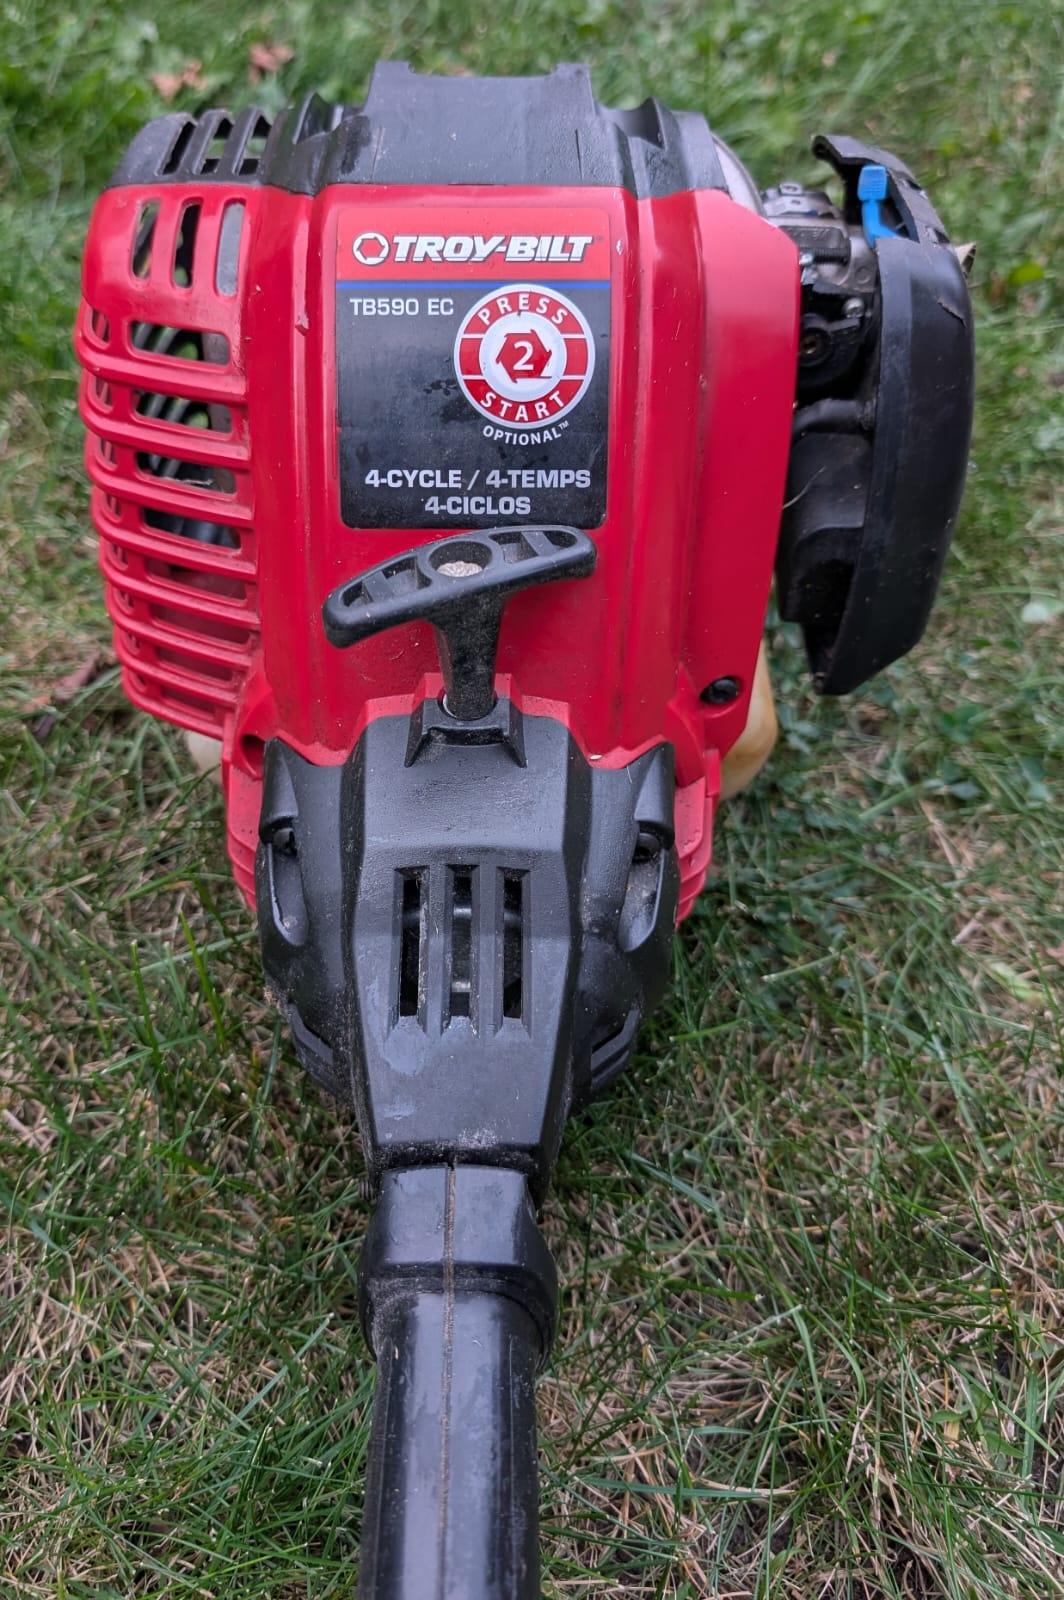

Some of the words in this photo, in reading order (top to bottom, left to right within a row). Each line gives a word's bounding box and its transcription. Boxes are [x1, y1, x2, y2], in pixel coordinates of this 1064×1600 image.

[392, 235, 594, 263] TROY-BILT
[349, 298, 419, 316] TB590
[427, 298, 454, 316] EC
[477, 293, 568, 326] PRESS
[512, 340, 534, 371] 2
[480, 391, 565, 421] START
[364, 469, 462, 489] 4-CYCLE
[466, 469, 481, 490] /
[485, 469, 592, 489] 4-TEMPS
[424, 496, 531, 515] 4-CICLOS
